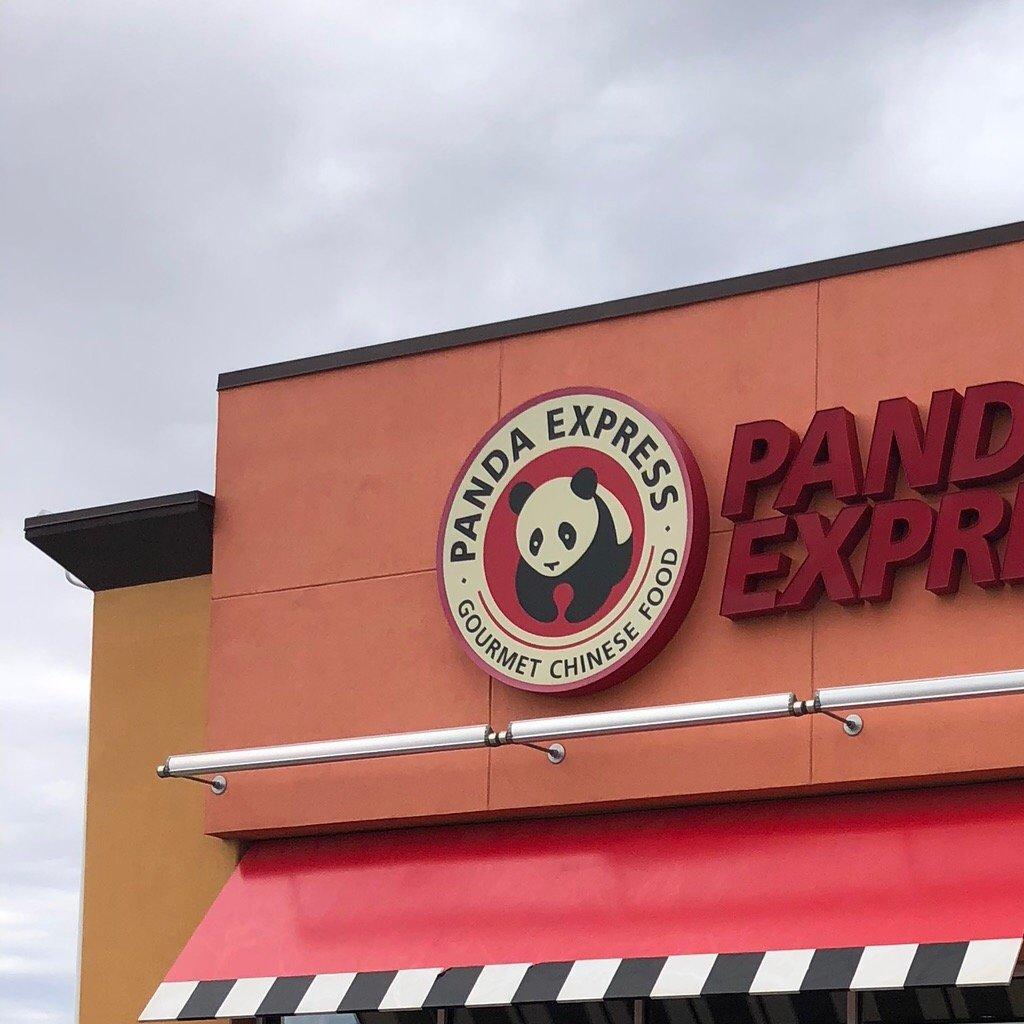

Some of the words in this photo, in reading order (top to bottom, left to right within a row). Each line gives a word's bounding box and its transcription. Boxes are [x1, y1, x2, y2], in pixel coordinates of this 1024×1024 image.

[450, 427, 536, 563] PANDA
[546, 405, 679, 511] EXPRESS
[458, 599, 542, 679] GOURMET
[549, 621, 639, 679] CHINESE
[638, 547, 678, 620] FOOD
